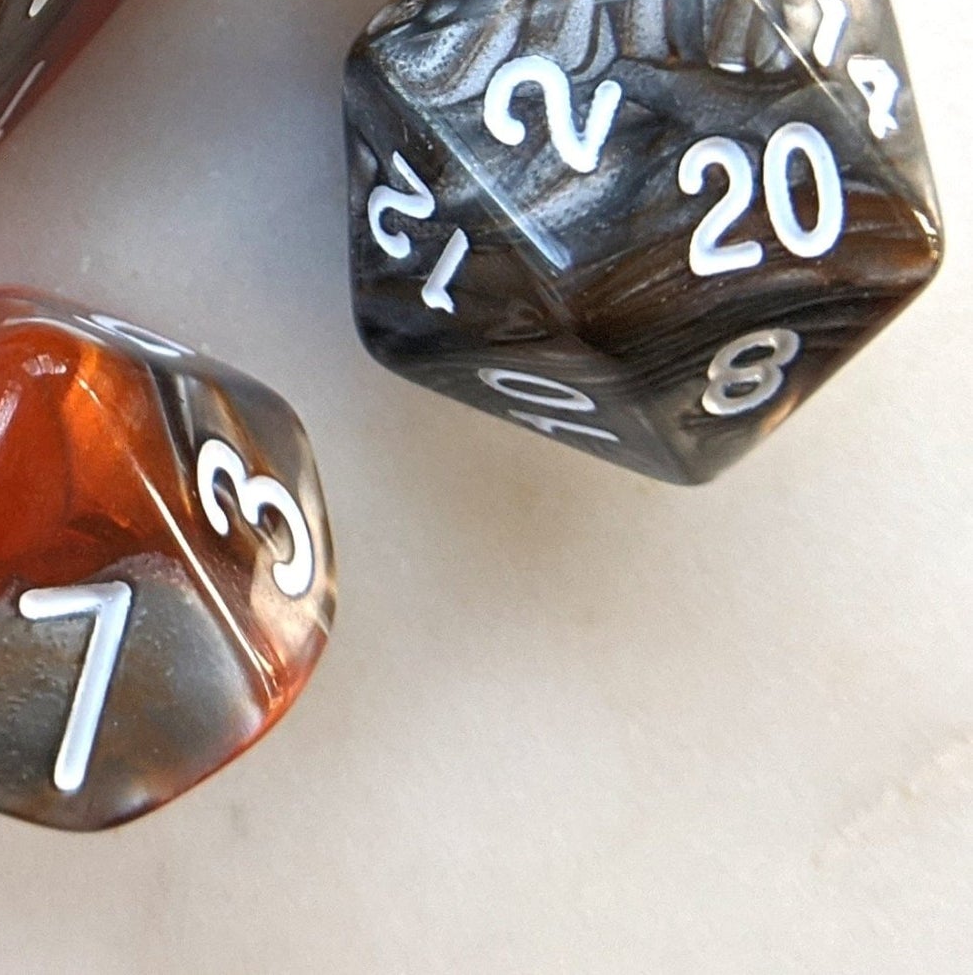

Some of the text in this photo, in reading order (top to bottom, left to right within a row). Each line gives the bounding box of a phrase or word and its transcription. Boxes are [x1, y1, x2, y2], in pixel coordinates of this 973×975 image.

[483, 55, 622, 173] 2
[368, 151, 468, 313] 12
[678, 123, 844, 276] 20
[478, 368, 619, 442] 10
[702, 329, 800, 415] 8
[197, 438, 314, 598] 3
[19, 581, 131, 790] 7
